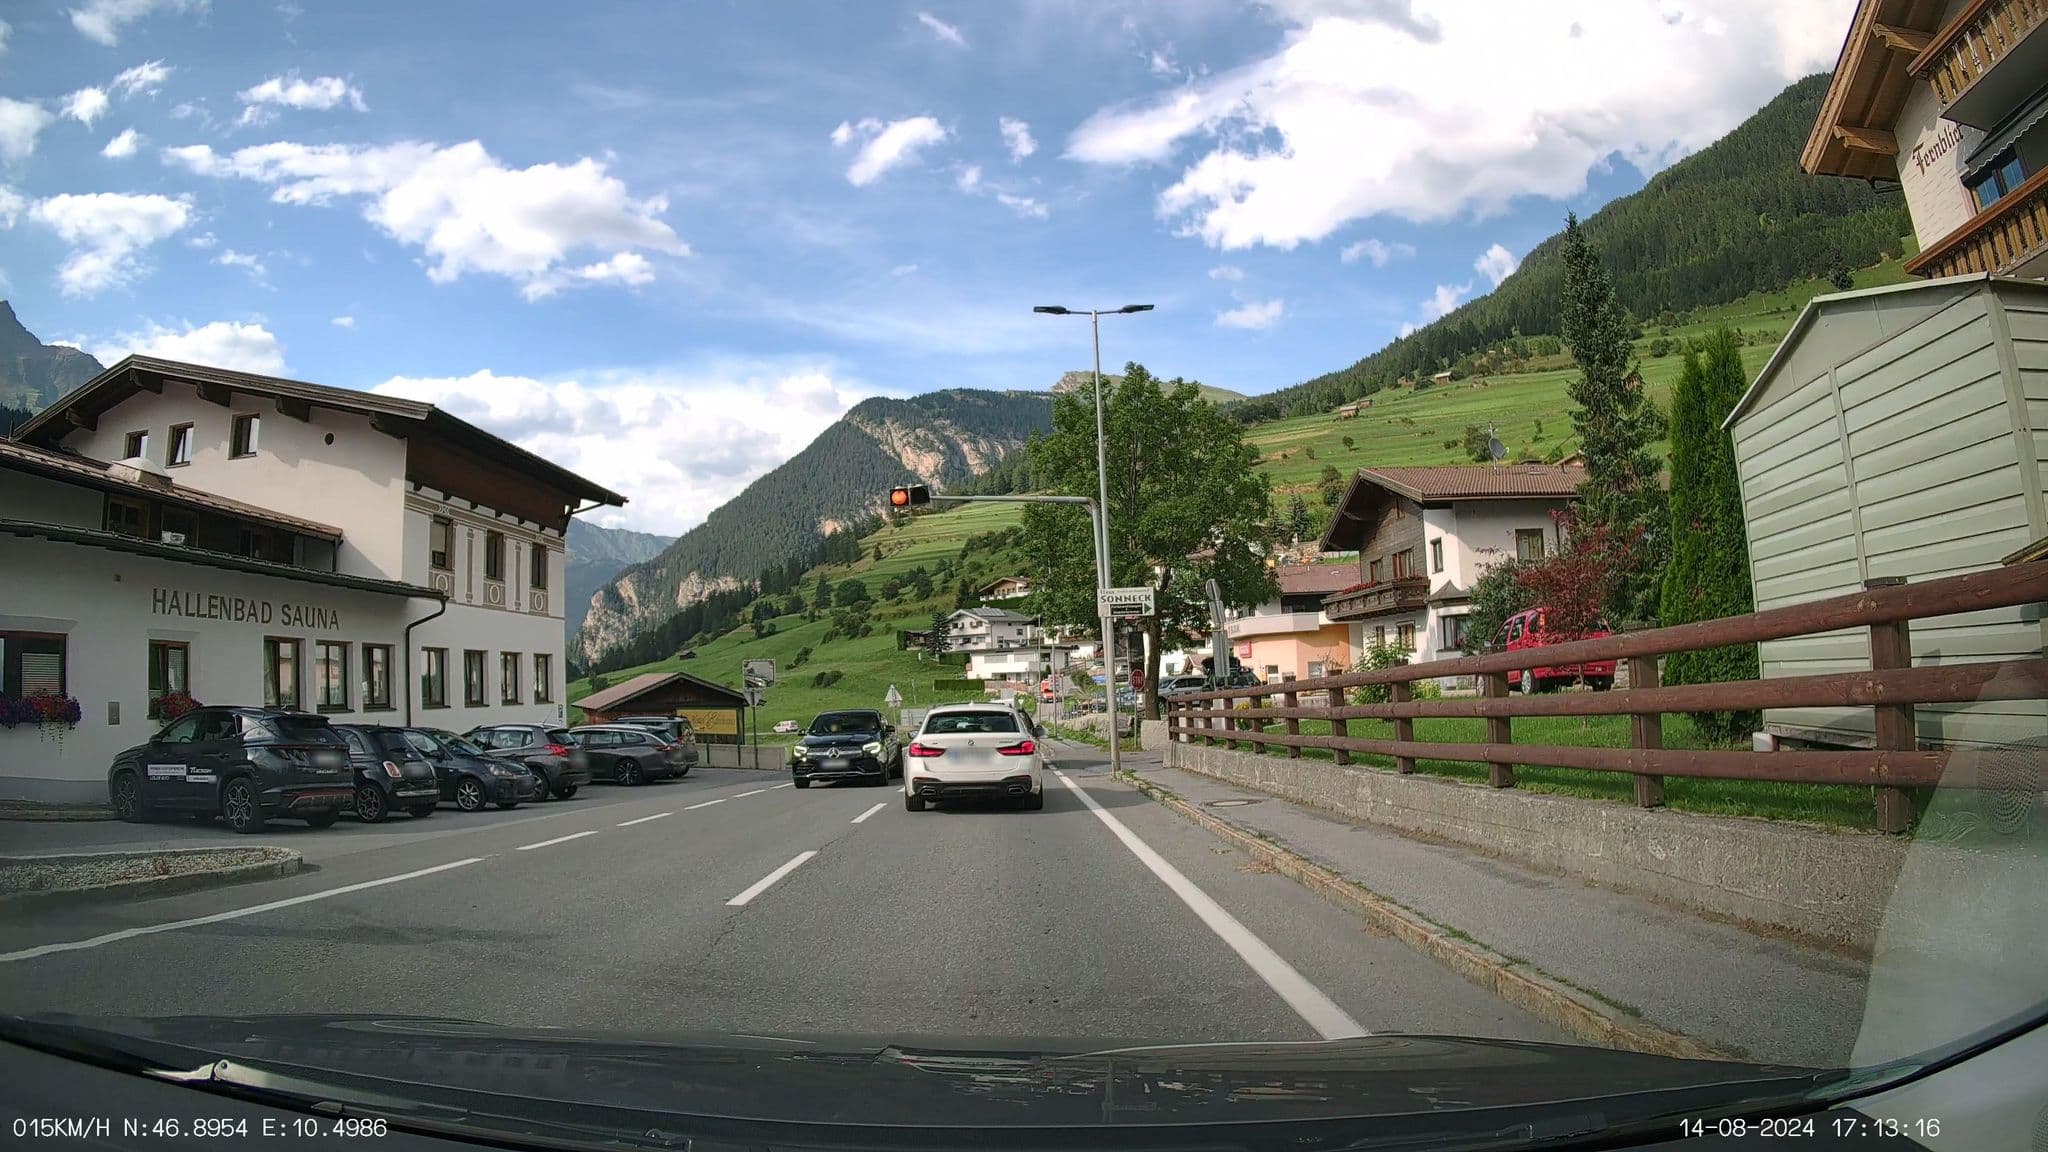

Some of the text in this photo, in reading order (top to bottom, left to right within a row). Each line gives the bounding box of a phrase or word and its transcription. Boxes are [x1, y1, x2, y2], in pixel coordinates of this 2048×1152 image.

[152, 587, 340, 631] HALLENBAD SAUNA
[1100, 594, 1152, 603] SONNECK
